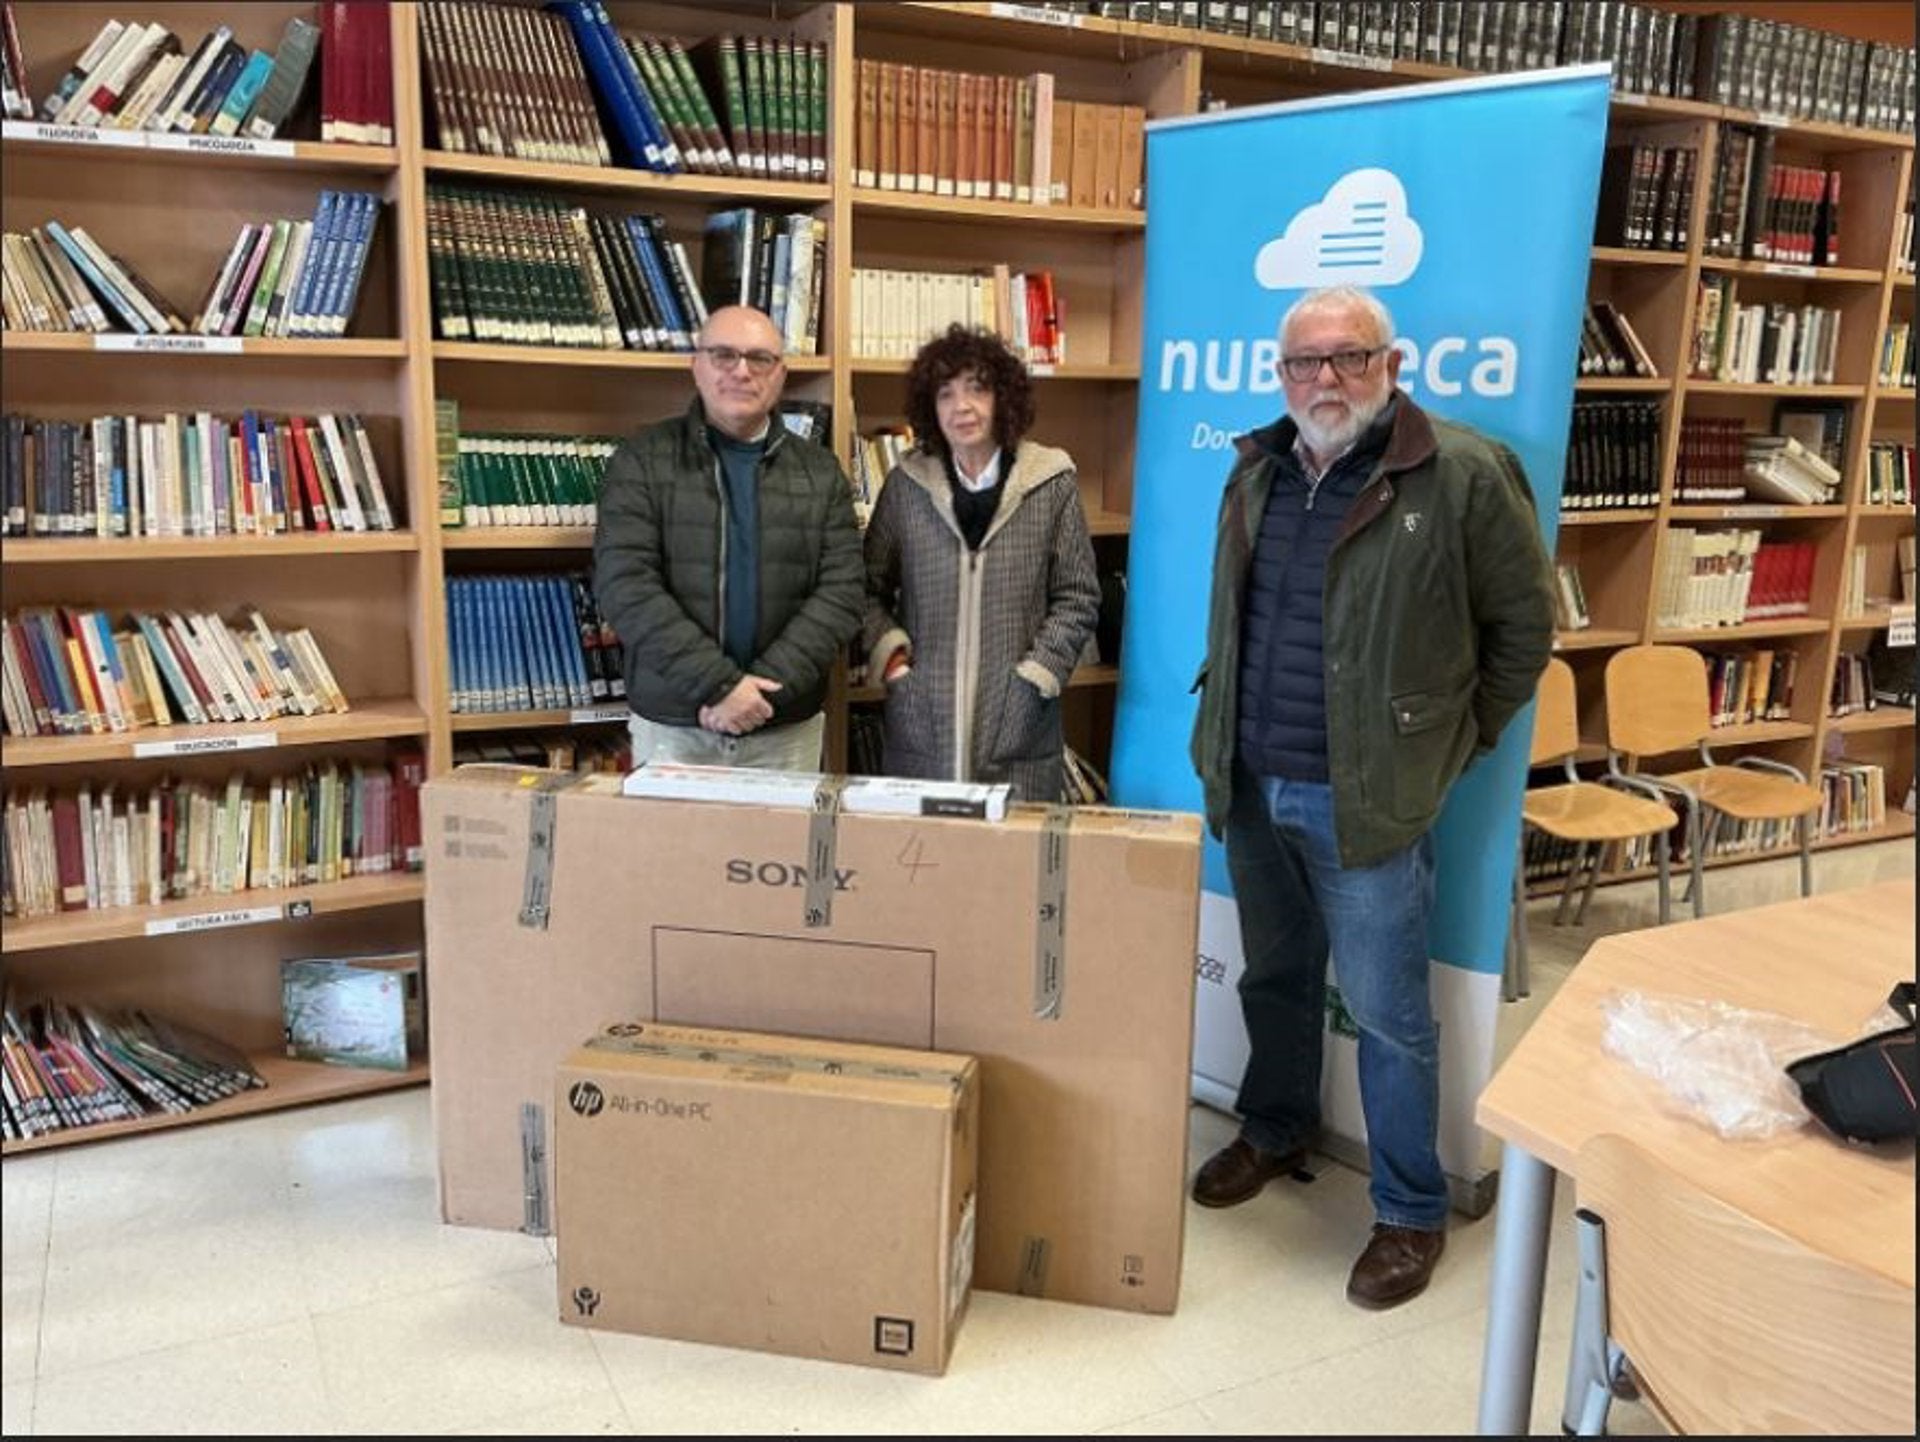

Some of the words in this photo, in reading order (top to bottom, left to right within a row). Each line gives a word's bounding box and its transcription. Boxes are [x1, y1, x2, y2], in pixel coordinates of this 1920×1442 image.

[1159, 336, 1519, 397] nuBeca
[896, 832, 940, 884] 4
[569, 1080, 604, 1117] hp
[689, 1101, 713, 1122] PC
